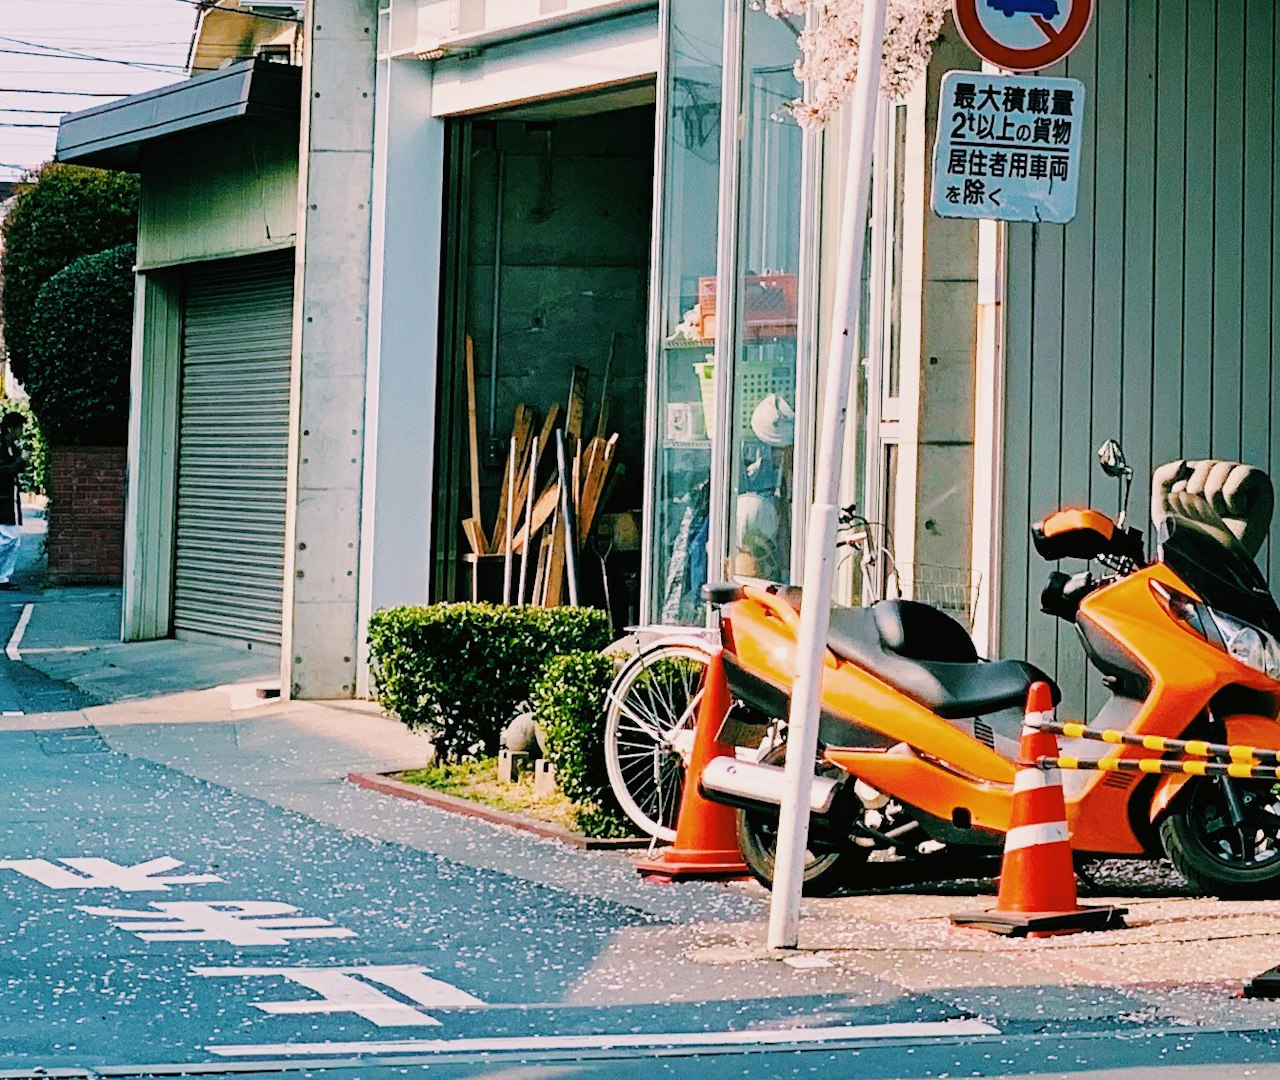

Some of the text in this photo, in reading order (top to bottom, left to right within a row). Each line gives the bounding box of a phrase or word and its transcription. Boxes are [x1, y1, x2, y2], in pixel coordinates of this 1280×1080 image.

[953, 82, 1075, 116] 最大積載量
[950, 111, 1072, 145] 2t以上の貨物
[947, 149, 1070, 181] 居住者用車両
[945, 178, 1001, 206] を除く
